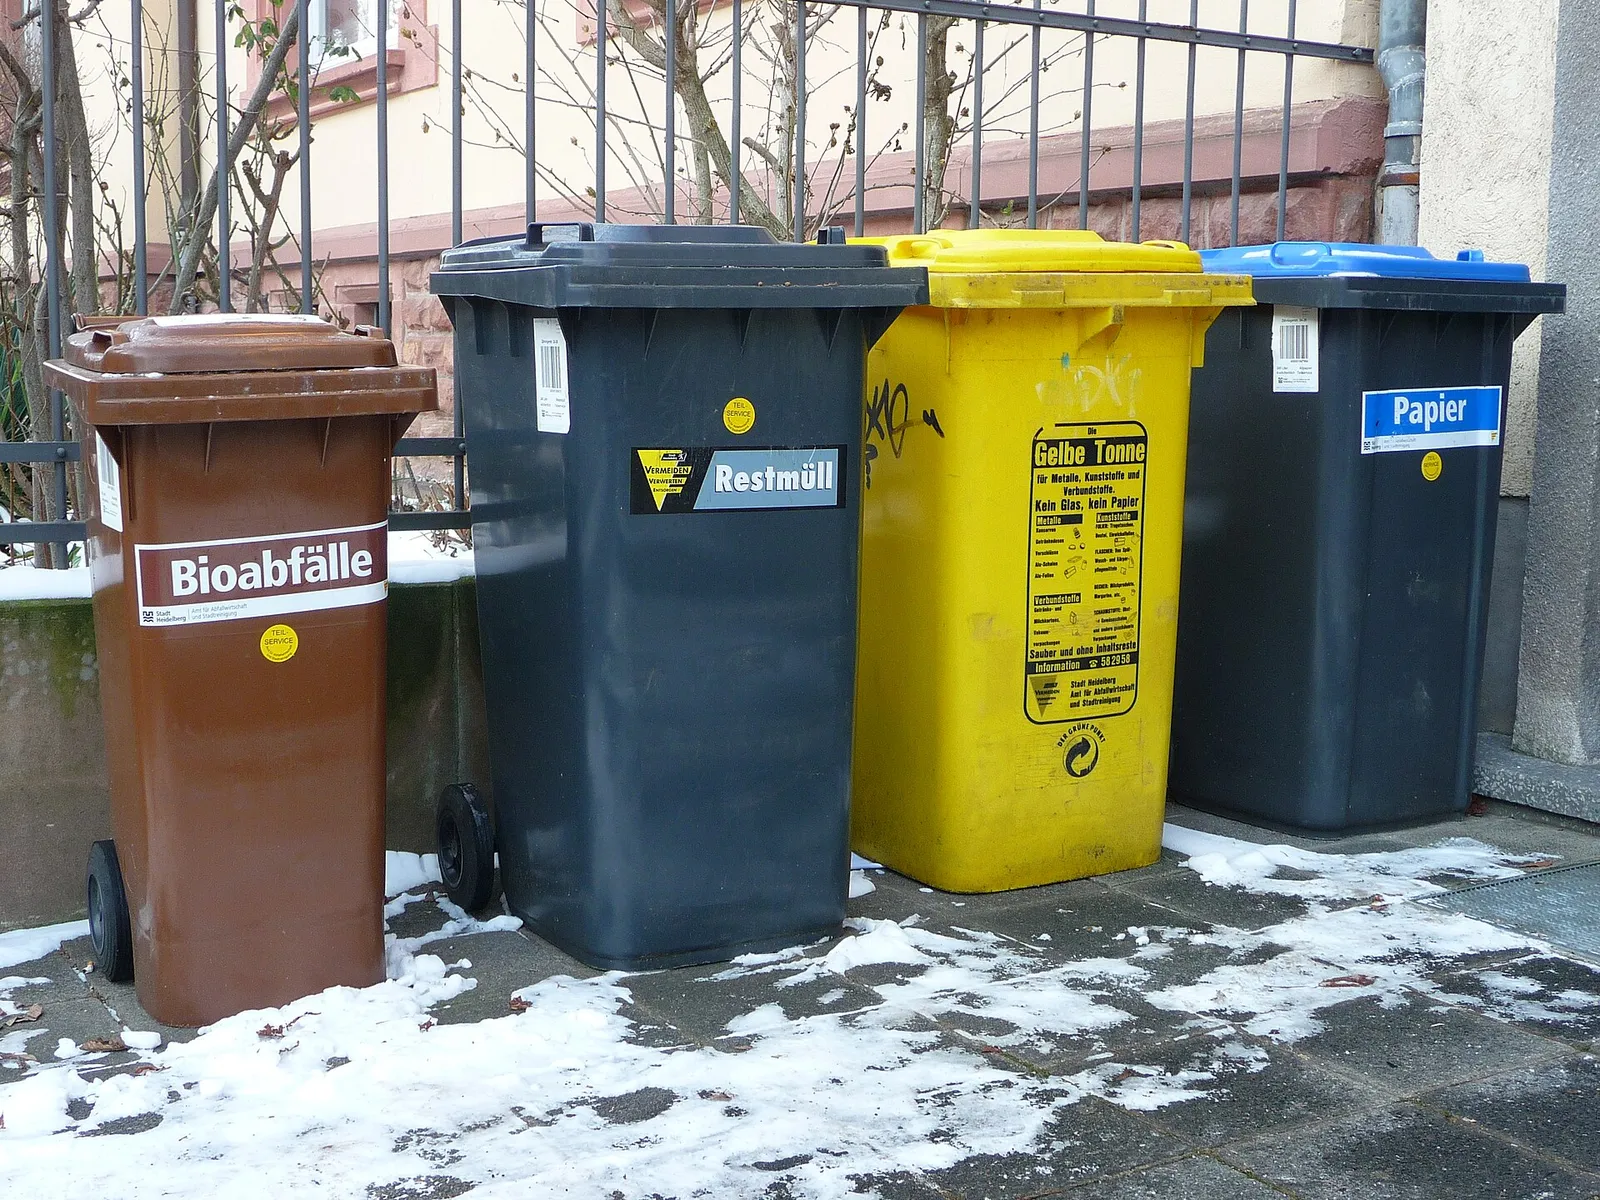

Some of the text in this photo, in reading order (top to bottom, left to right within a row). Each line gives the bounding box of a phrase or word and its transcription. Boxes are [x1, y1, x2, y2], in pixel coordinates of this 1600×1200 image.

[1394, 392, 1466, 432] Papier
[1034, 440, 1145, 466] Gelbe Tonne
[715, 460, 833, 492] Restmüll
[1037, 470, 1140, 484] für Metalle, Kunststoffe und
[1064, 484, 1115, 496] Verbundstoffe.
[1036, 496, 1139, 512] Kein Glas, kein Papier
[1036, 516, 1062, 525] Metalle
[1097, 513, 1131, 522] Kunststoffe
[171, 541, 372, 597] Bioabfälle
[1035, 594, 1080, 605] Verbundstoffe
[210, 603, 247, 612] Abfallwirtschaft
[202, 610, 238, 619] Stadtreinigung
[1030, 640, 1136, 659] Sauber und ohne Inhaltsreste
[1035, 660, 1080, 673] Information
[1071, 677, 1116, 688] Stadt Heidelberg
[1070, 690, 1082, 698] Amt
[1094, 684, 1135, 695] Abfallwirtschaft
[1082, 696, 1121, 707] Stadtreinigung
[1057, 723, 1106, 747] DER GRÜNE PUNKT
